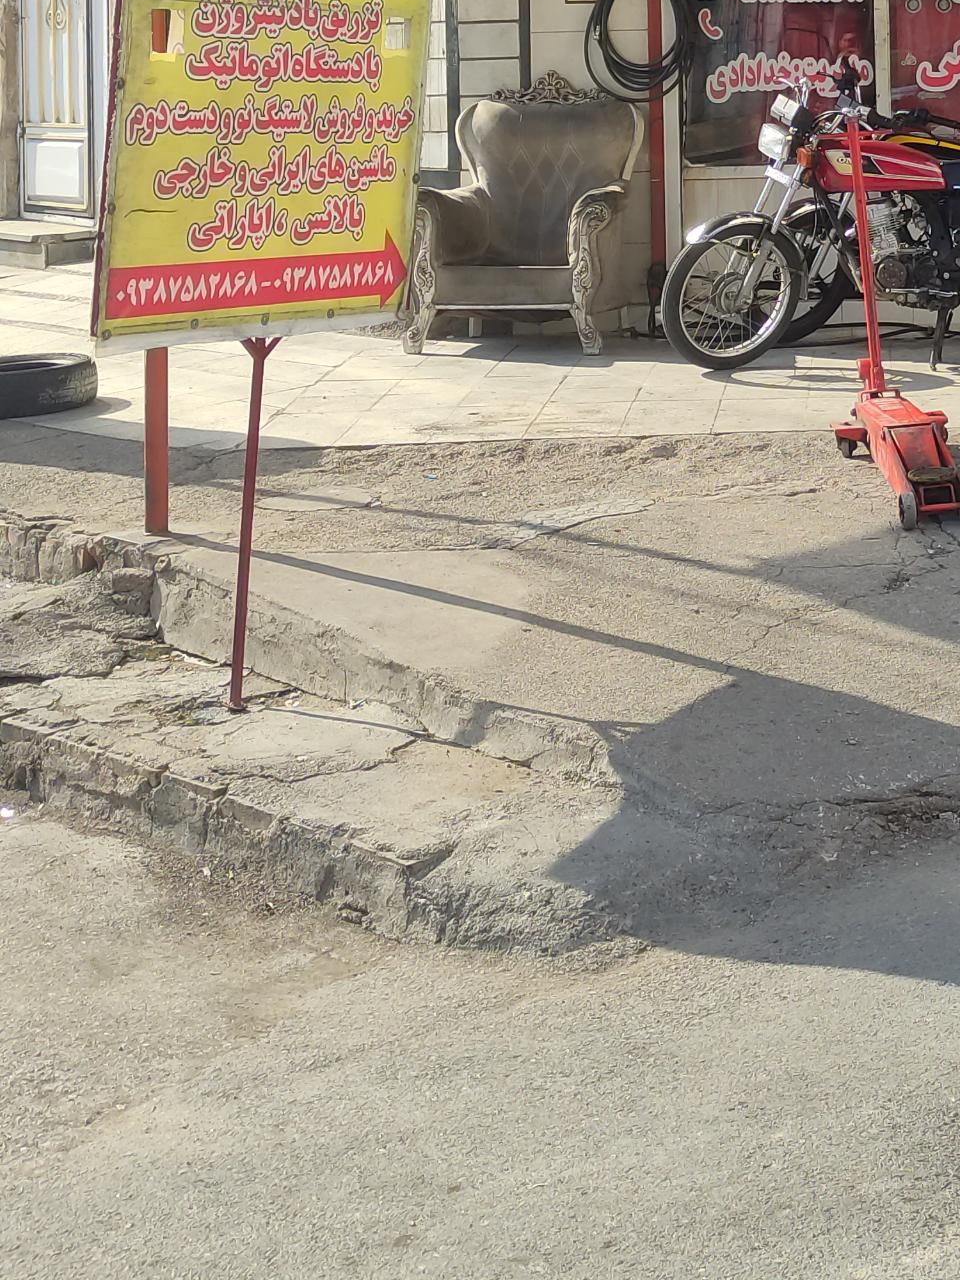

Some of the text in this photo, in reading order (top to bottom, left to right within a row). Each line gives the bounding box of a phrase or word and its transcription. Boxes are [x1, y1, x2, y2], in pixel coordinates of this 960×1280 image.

[187, 41, 382, 91] با دستگاه اتوماتیک
[126, 101, 170, 144] دوم
[170, 101, 218, 135] دست
[315, 94, 366, 143] فروش
[363, 110, 376, 143] و
[376, 95, 414, 142] خرید
[156, 147, 235, 198] خارجی
[231, 163, 248, 197] و
[249, 146, 310, 196] ایرانی
[346, 147, 396, 190] ماشین
[291, 196, 364, 243] بالانس
